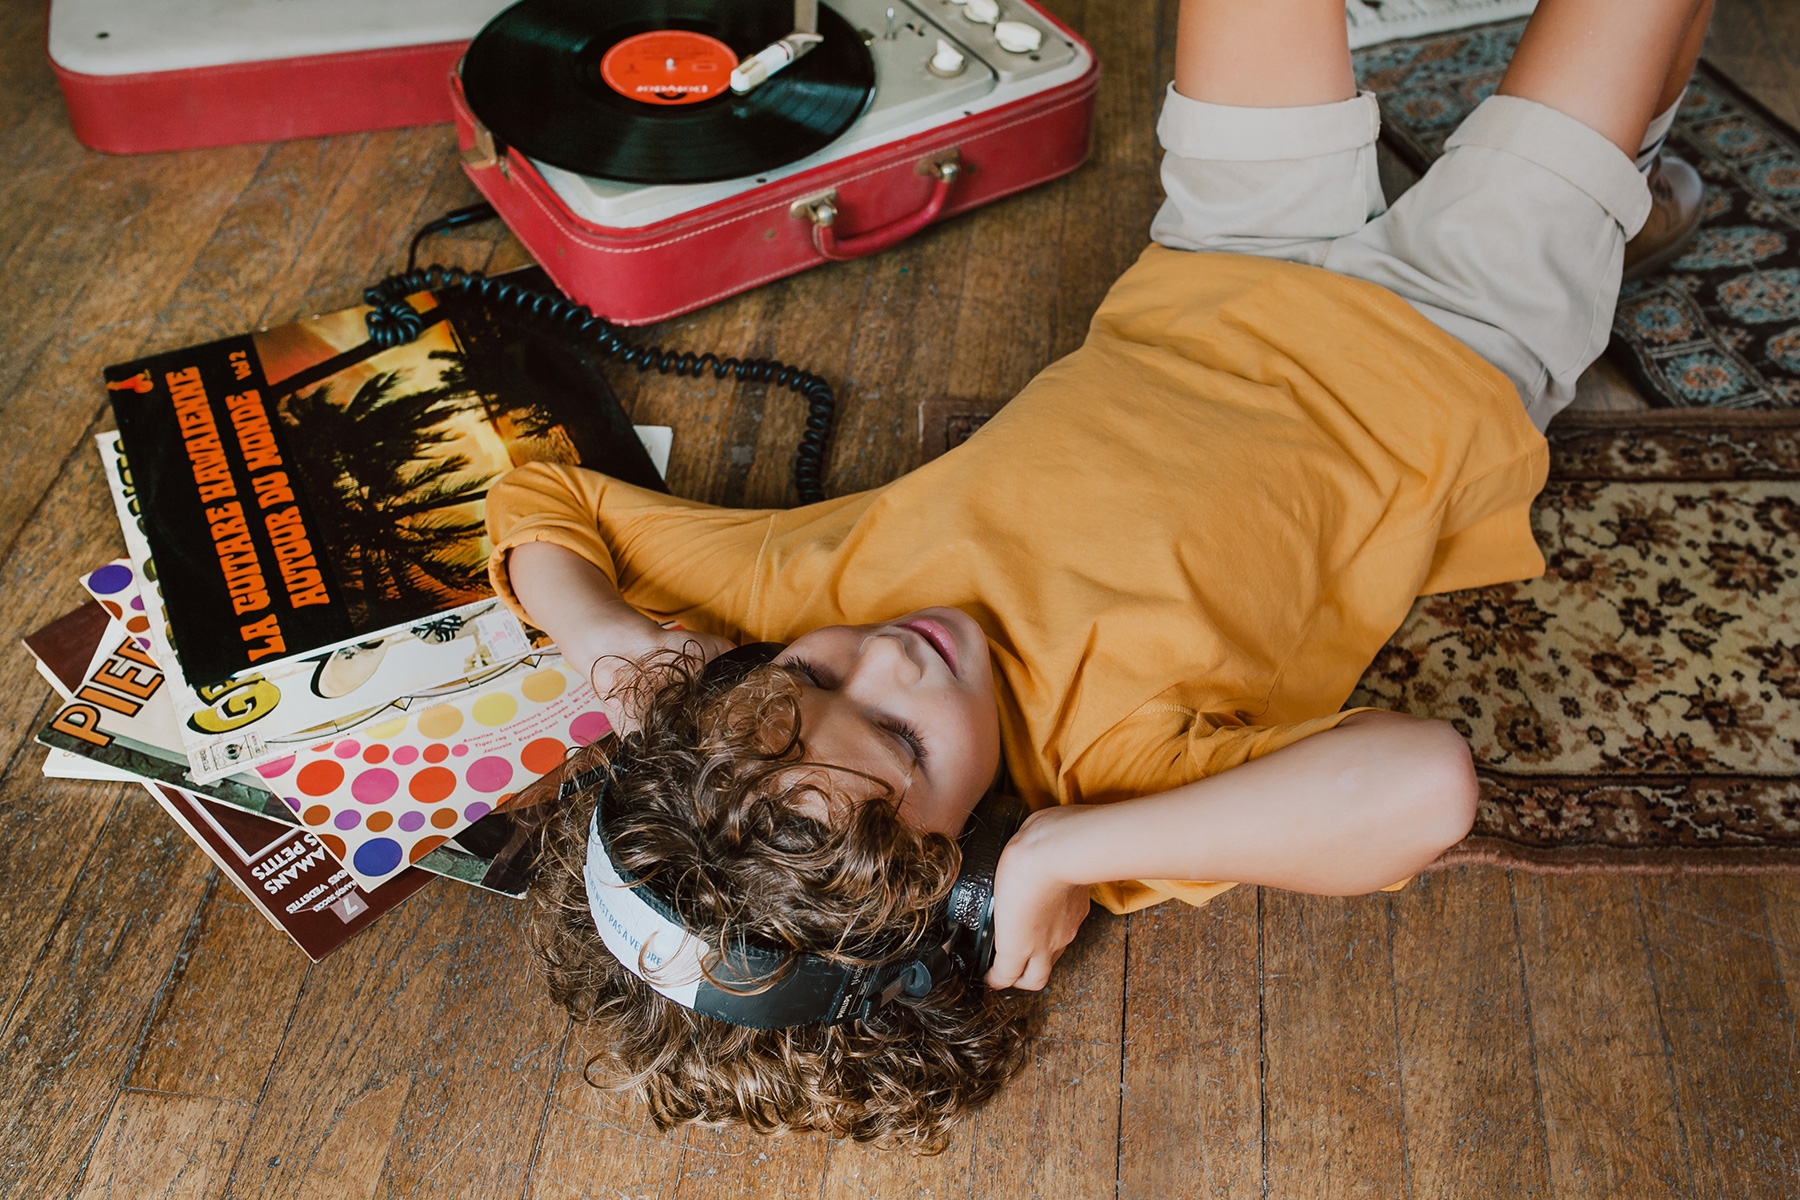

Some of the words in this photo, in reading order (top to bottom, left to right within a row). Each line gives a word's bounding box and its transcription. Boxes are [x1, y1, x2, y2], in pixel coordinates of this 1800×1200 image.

[229, 350, 247, 361] 2
[165, 366, 238, 503] HAWAIENNE
[225, 389, 283, 472] MONDE
[252, 471, 295, 509] DU
[205, 501, 271, 615] GUITARE
[264, 505, 331, 608] AUTOUR
[240, 613, 287, 662] LA
[251, 841, 307, 881] PETITS
[285, 883, 329, 914] VEDETTES
[343, 897, 359, 915] 7
[608, 914, 623, 937] PAS
